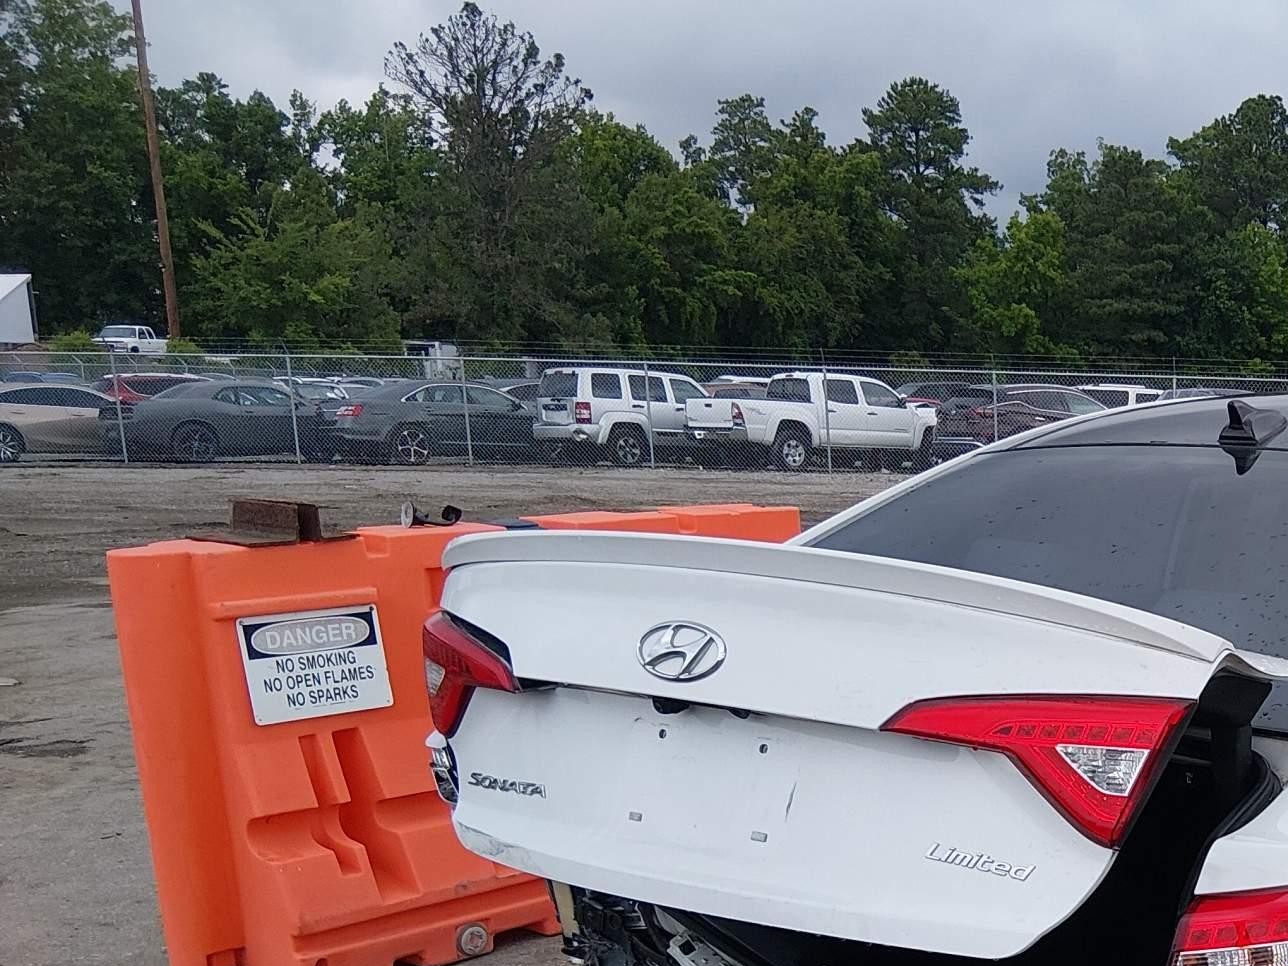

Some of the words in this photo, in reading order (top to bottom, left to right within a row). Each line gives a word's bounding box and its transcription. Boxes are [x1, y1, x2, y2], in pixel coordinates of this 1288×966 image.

[265, 622, 357, 649] DANGER
[275, 658, 295, 674] NO
[298, 651, 356, 671] SMOKING
[263, 677, 283, 693] NO
[286, 672, 321, 690] OPEN
[324, 664, 375, 685] FLAMES
[286, 692, 306, 707] NO
[309, 685, 359, 704] SPARKS
[467, 772, 547, 799] SONATA
[924, 841, 1037, 882] Limited
